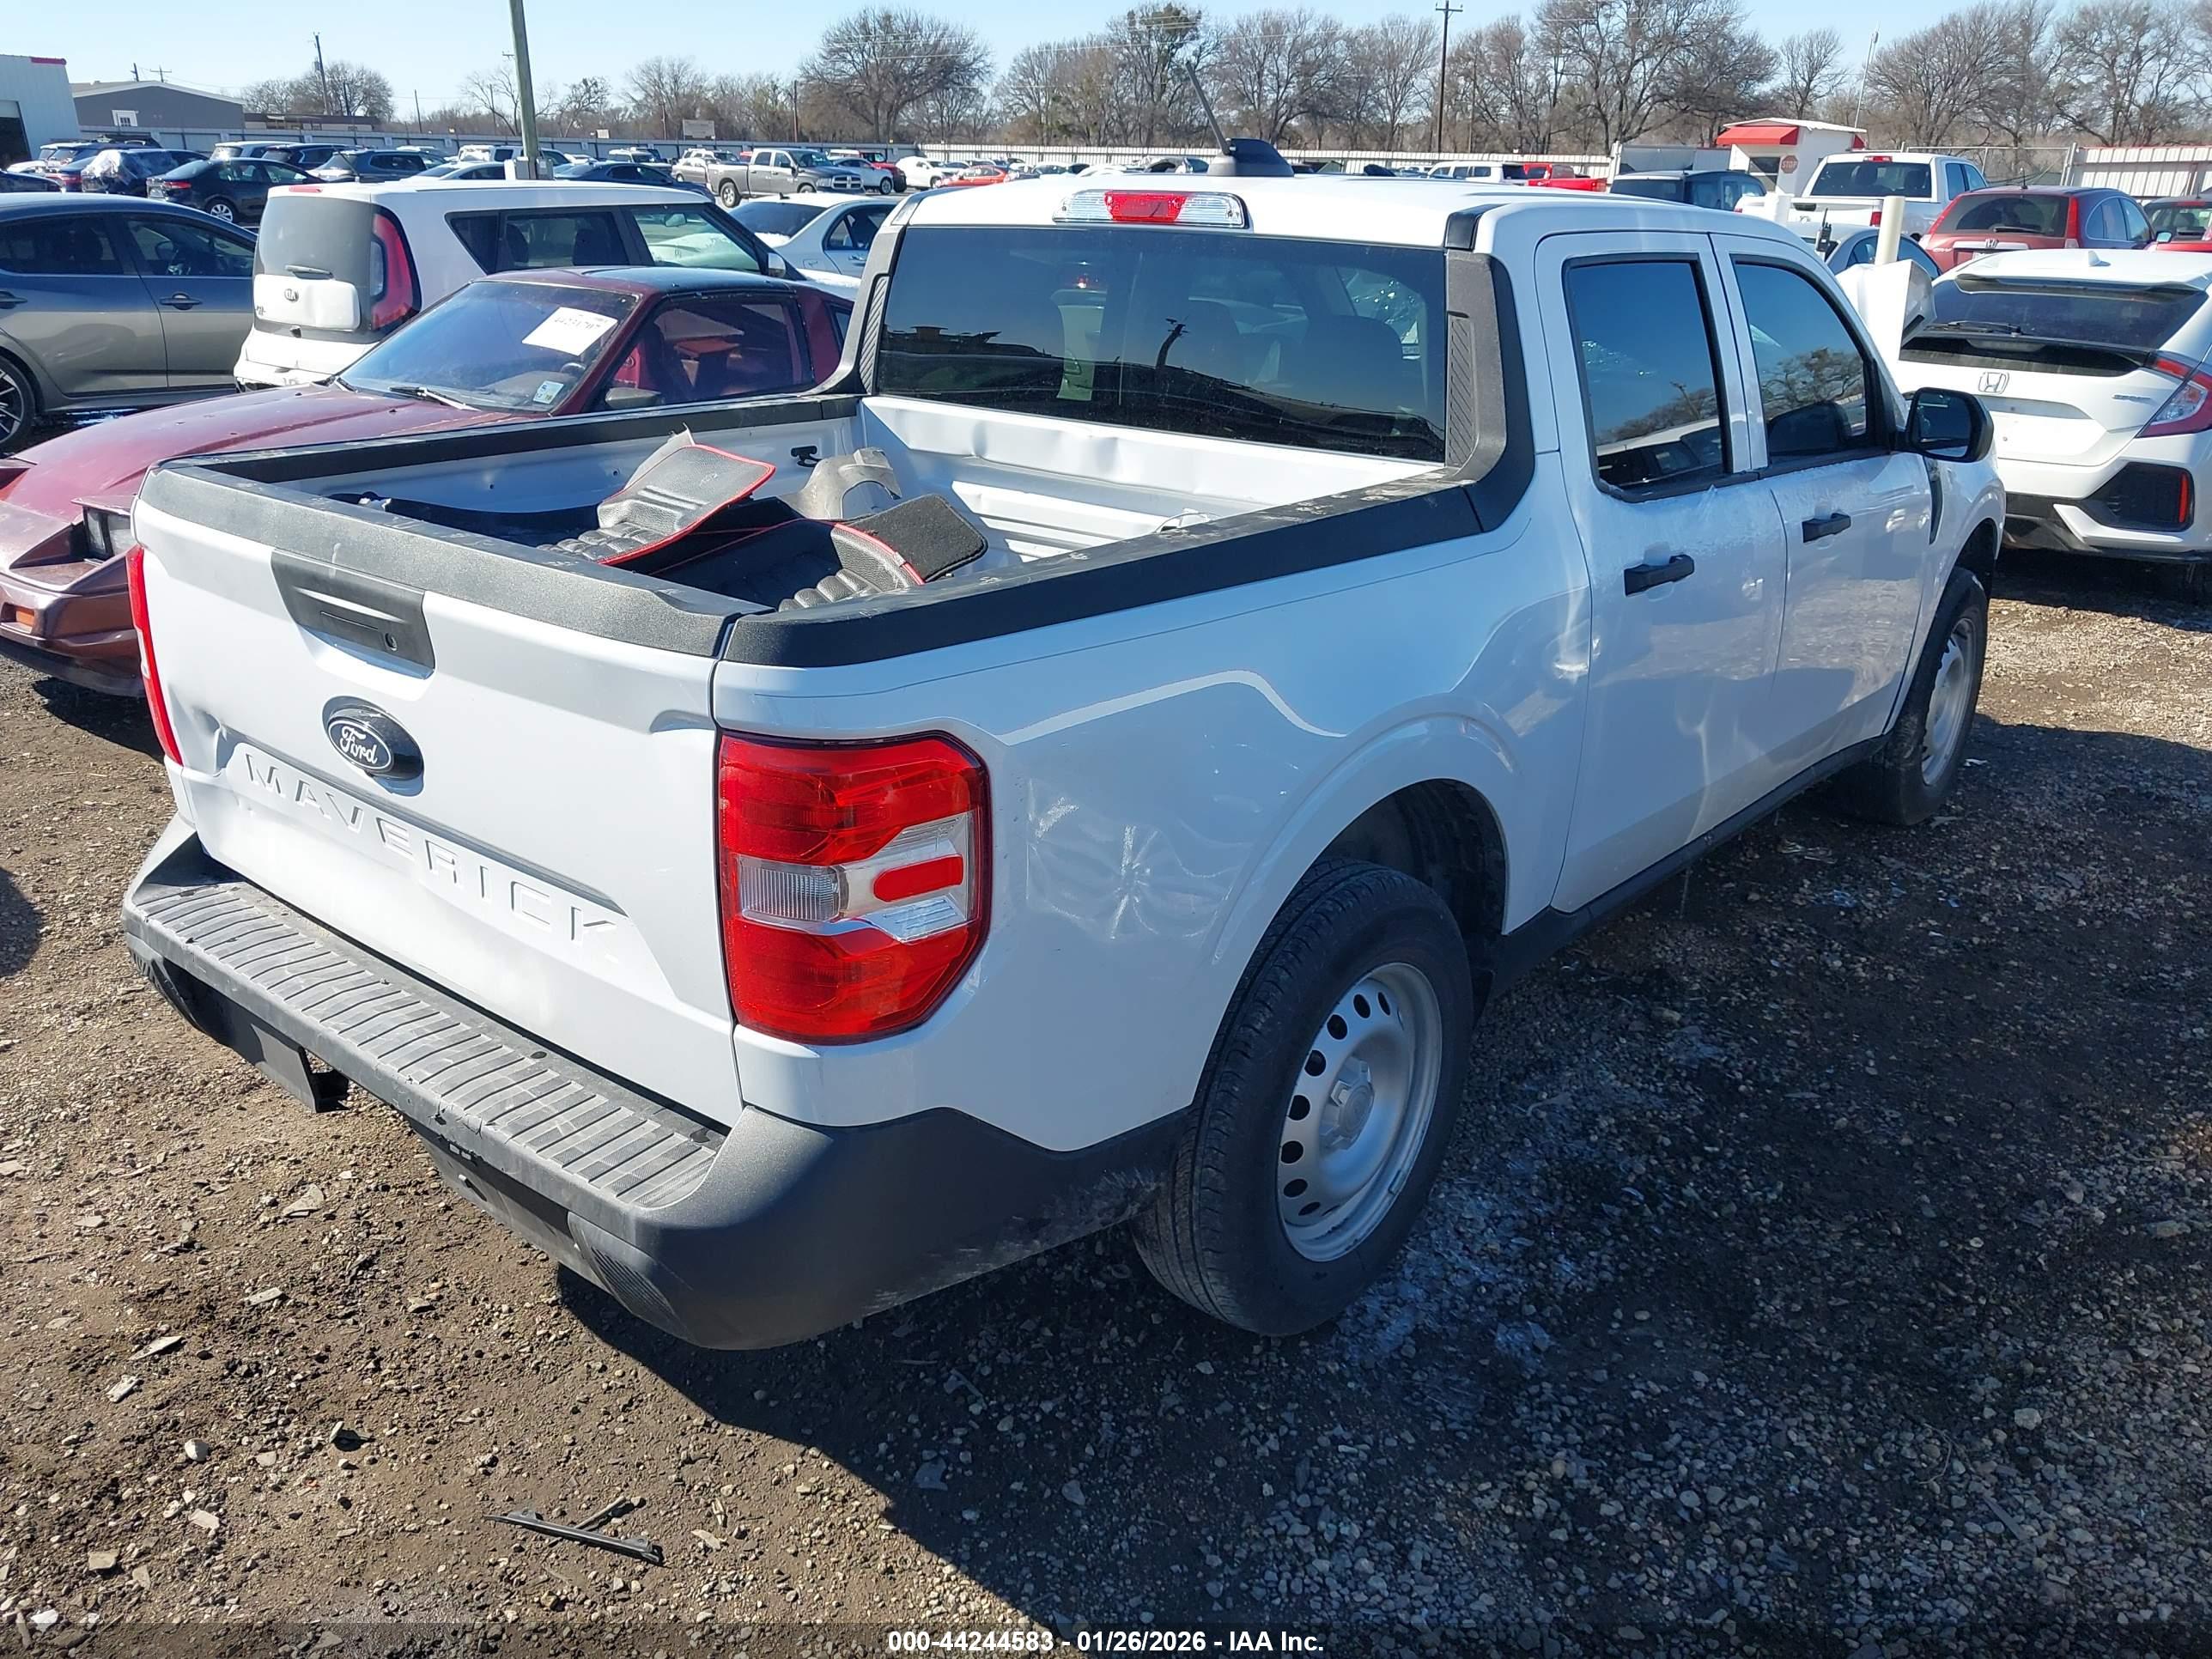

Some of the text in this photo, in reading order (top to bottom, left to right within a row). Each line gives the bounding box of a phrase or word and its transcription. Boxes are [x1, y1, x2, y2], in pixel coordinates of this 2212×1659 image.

[1781, 160, 1799, 170] STOP
[339, 725, 379, 764] Ford
[244, 752, 619, 963] MAVERICK
